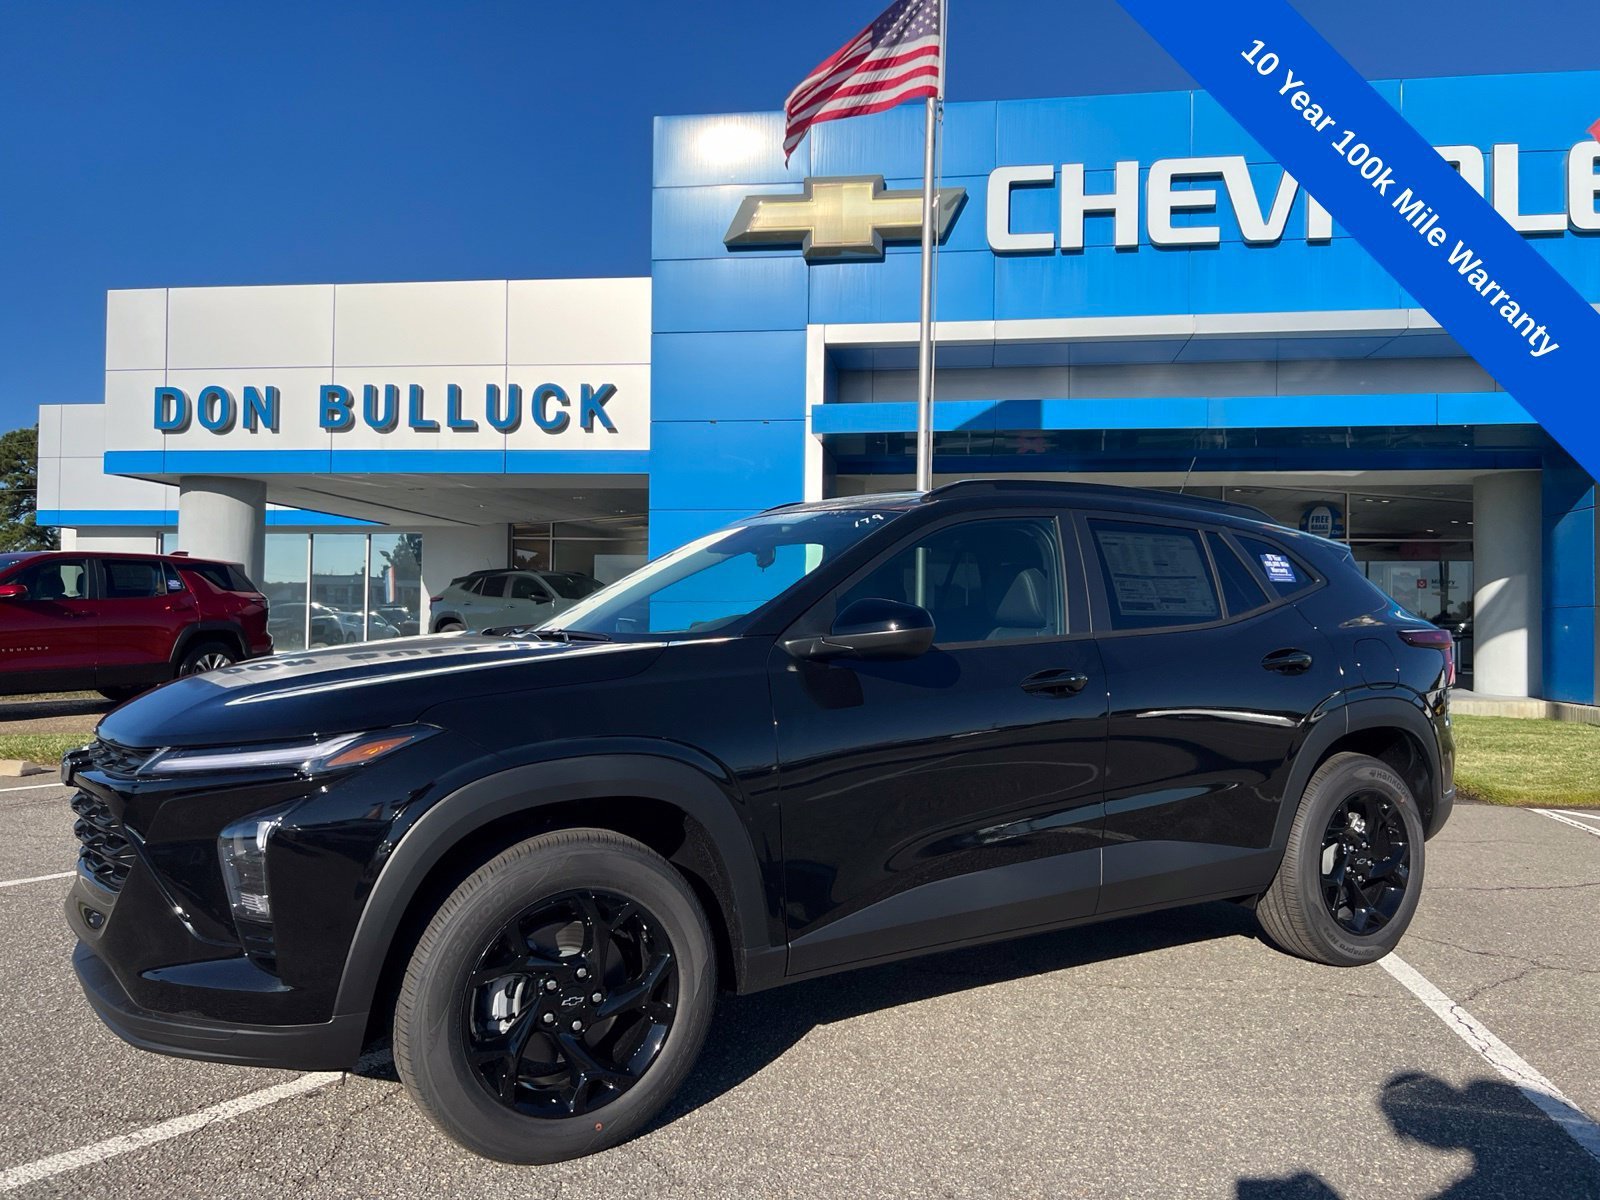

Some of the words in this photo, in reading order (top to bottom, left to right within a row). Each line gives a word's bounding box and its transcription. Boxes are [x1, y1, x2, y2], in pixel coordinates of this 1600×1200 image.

[153, 384, 281, 433] DON
[319, 383, 618, 433] BULLUCK
[1311, 515, 1329, 524] FREE
